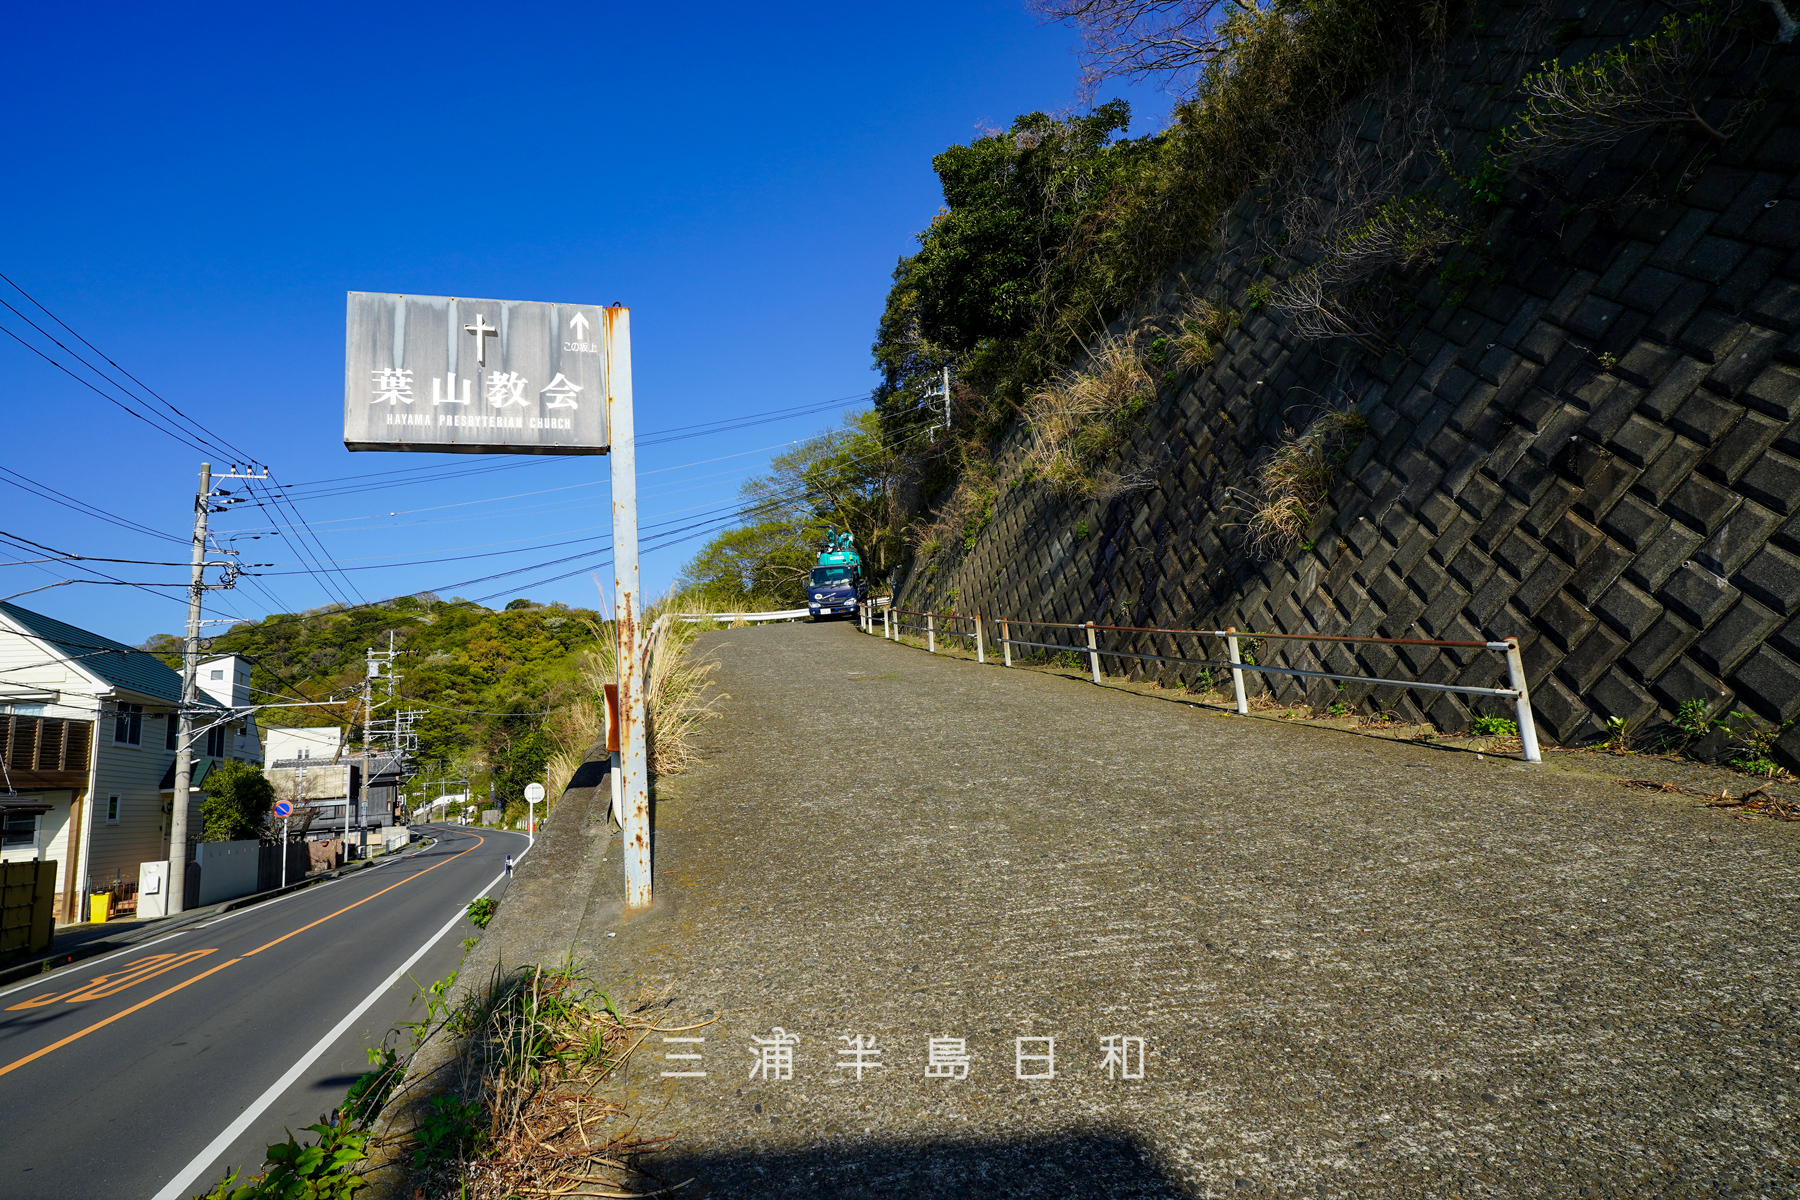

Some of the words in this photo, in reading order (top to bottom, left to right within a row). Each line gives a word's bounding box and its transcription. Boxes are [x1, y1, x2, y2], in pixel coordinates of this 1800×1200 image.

[563, 341, 598, 353] この坂上
[370, 367, 584, 410] 葉山教会
[386, 413, 431, 427] HAYAMA
[439, 414, 523, 429] PRESBYTERIAN
[529, 416, 571, 430] CHURCH
[4, 948, 219, 1011] 30
